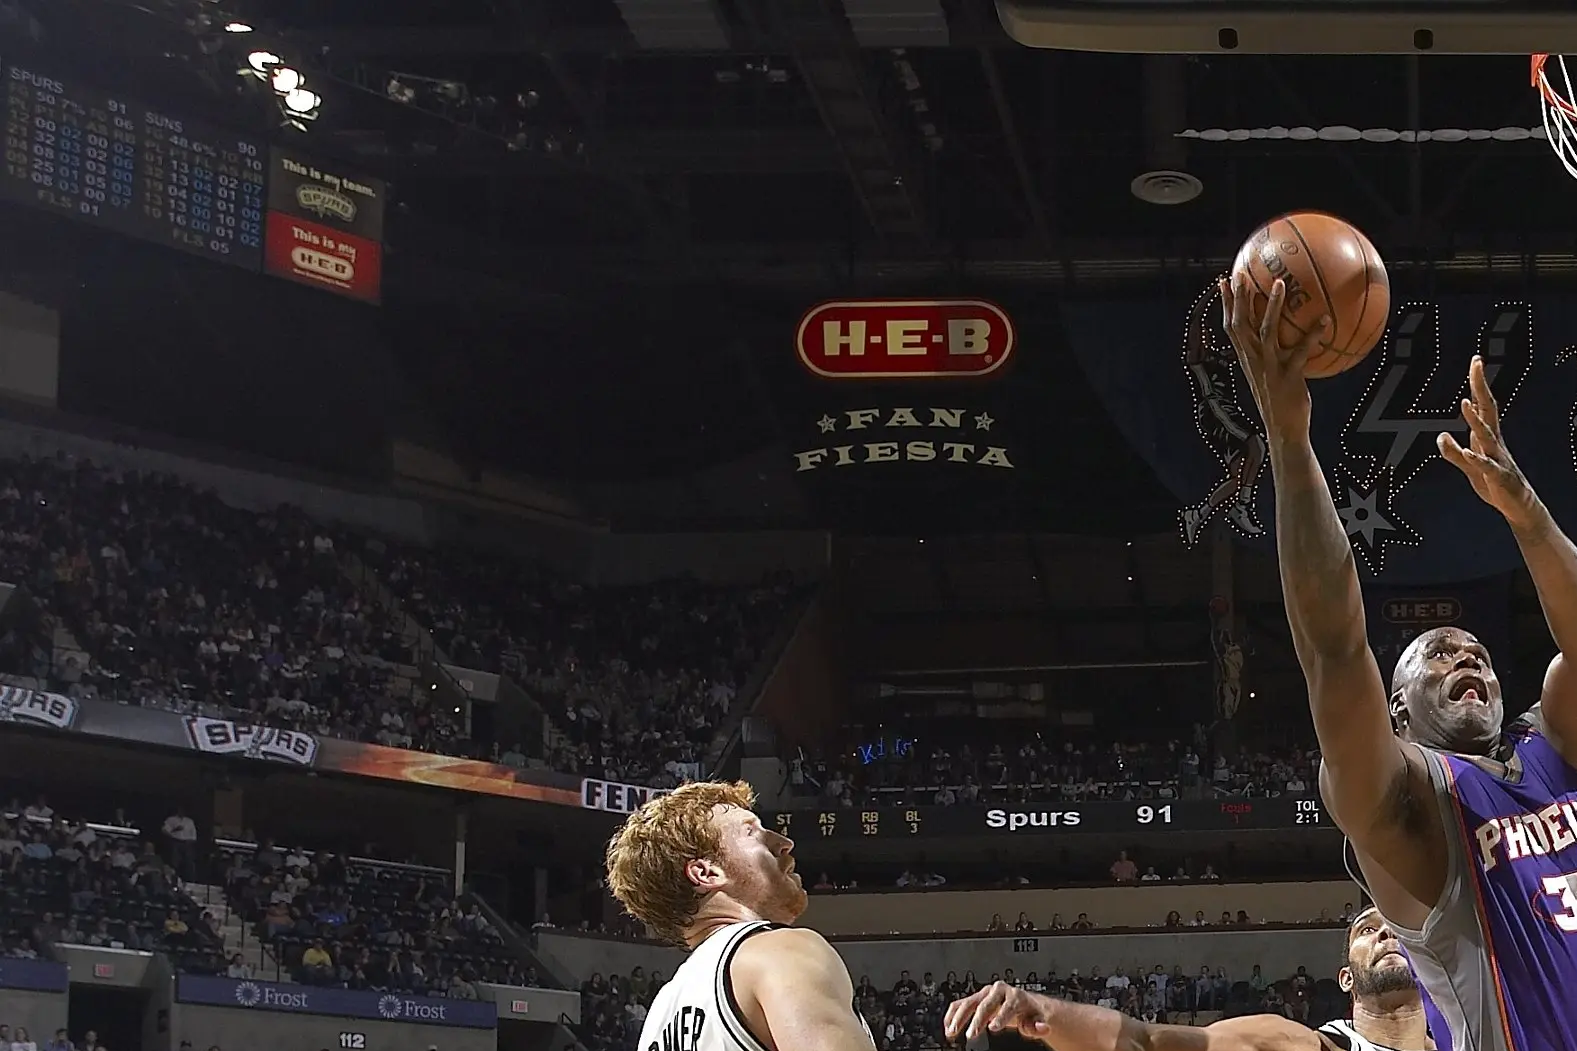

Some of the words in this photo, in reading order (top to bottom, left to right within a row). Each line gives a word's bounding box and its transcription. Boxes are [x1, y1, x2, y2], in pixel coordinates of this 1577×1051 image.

[9, 66, 64, 94] SPURS
[281, 158, 308, 177] This
[310, 167, 321, 180] is
[324, 173, 341, 192] my
[343, 177, 376, 198] team.
[303, 191, 350, 215] SPURS
[292, 226, 320, 245] This
[323, 236, 335, 249] is
[338, 242, 357, 264] my
[823, 319, 992, 355] H-E-B
[844, 407, 968, 431] FAN
[793, 440, 1015, 472] FIESTA
[204, 718, 310, 757] SPURS
[1295, 800, 1320, 812] TOL
[776, 813, 792, 825] ST
[818, 812, 836, 824] AS
[861, 811, 879, 823] RB
[905, 810, 922, 822] BL
[985, 808, 1081, 831] Spurs
[1136, 804, 1173, 824] 91
[1295, 812, 1320, 824] 2:1
[820, 824, 835, 836] 17
[863, 823, 878, 835] 35
[910, 822, 918, 834] 3
[1017, 939, 1035, 952] 113
[264, 986, 308, 1008] Frost
[405, 1000, 447, 1021] Frost
[340, 1033, 365, 1049] 112
